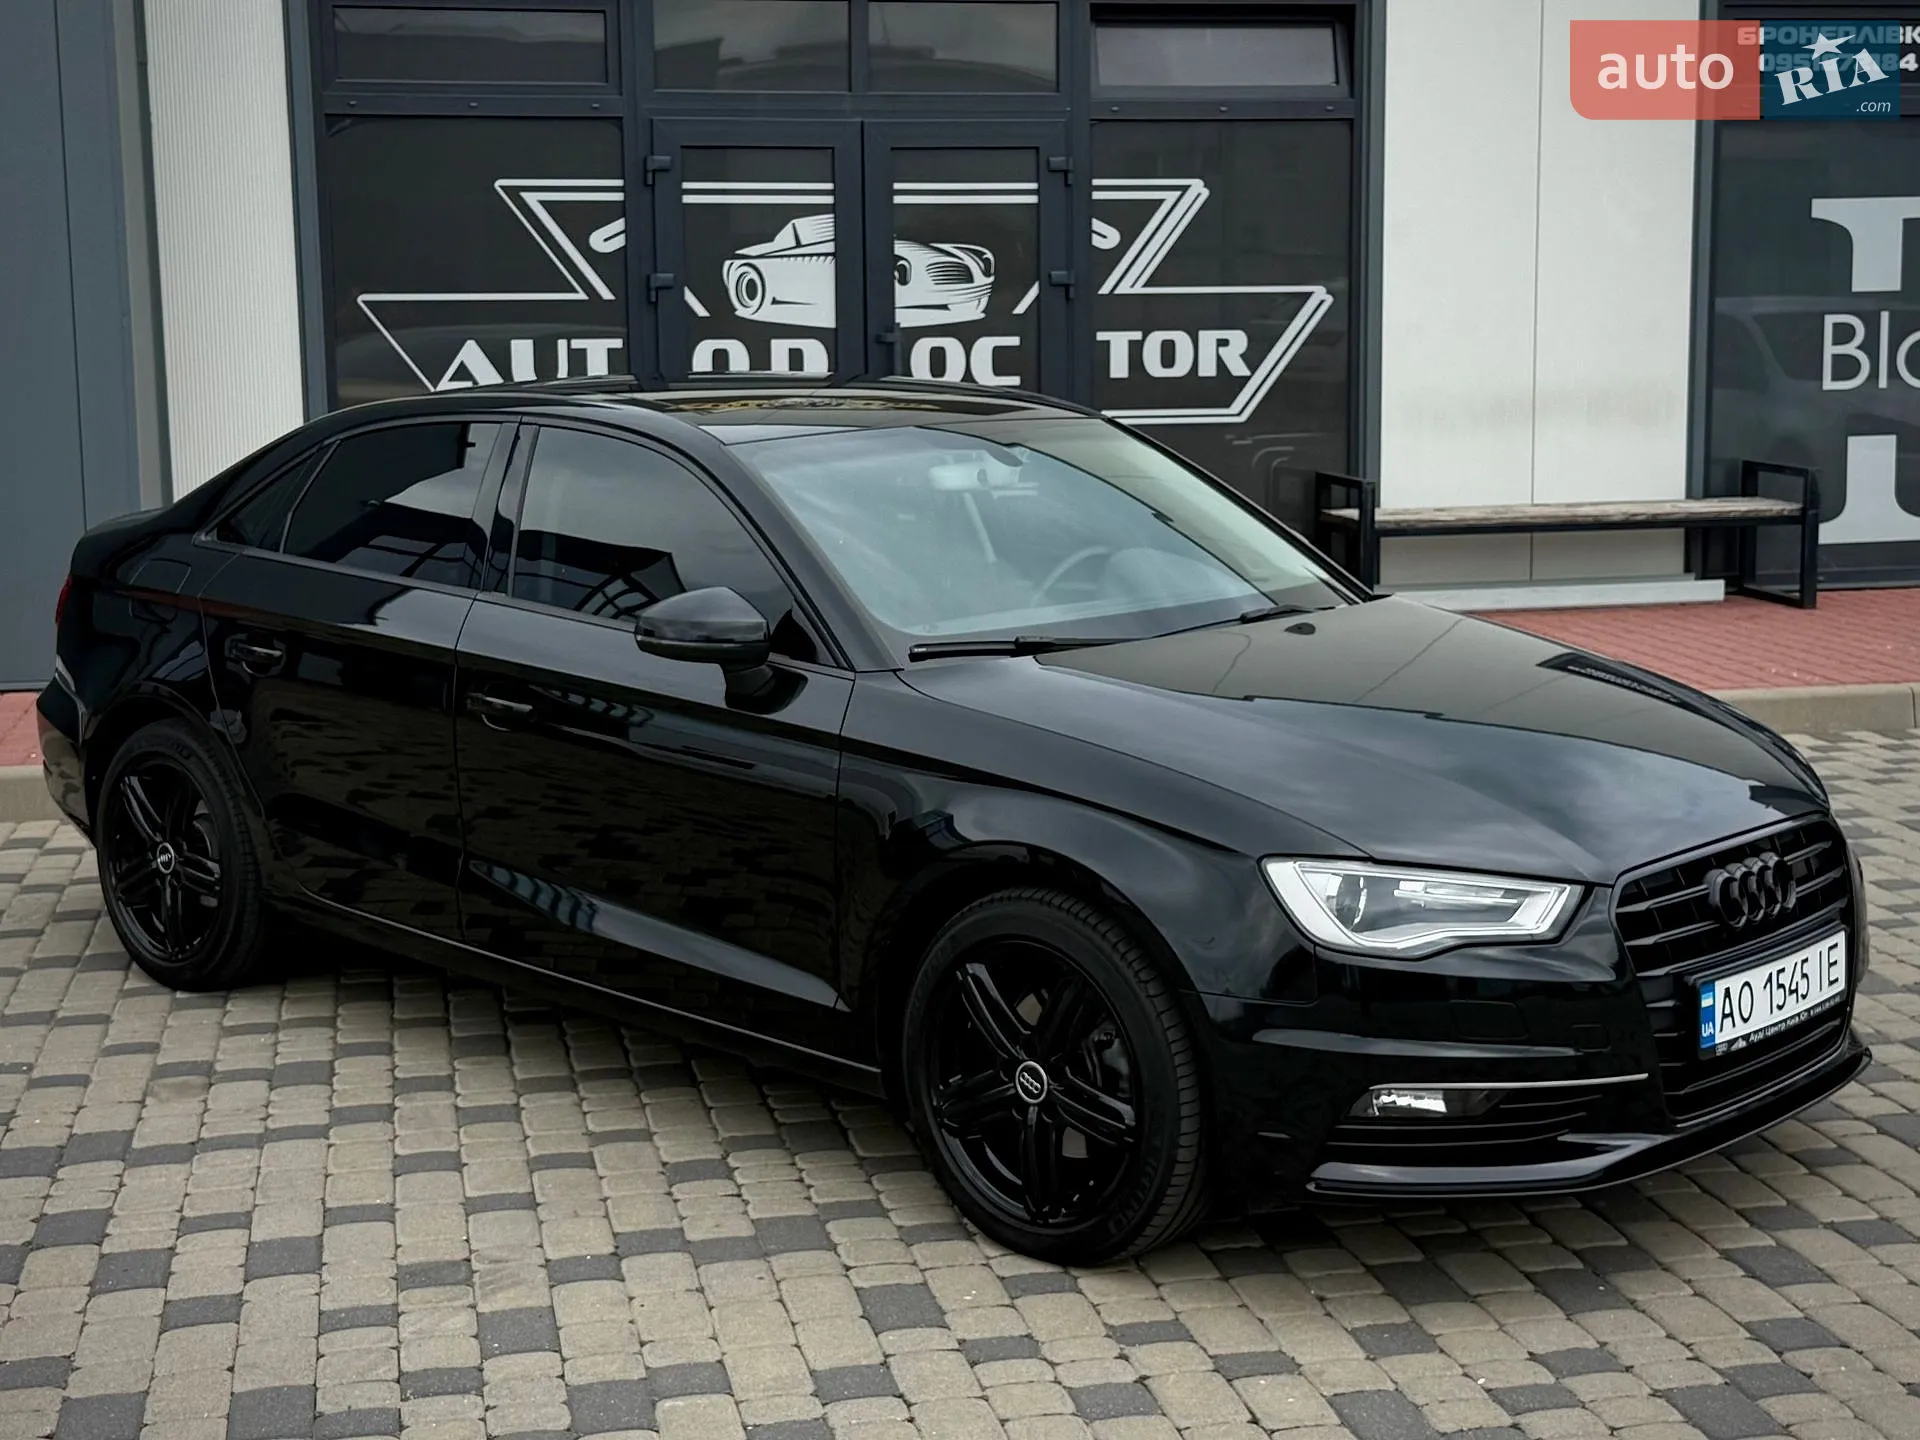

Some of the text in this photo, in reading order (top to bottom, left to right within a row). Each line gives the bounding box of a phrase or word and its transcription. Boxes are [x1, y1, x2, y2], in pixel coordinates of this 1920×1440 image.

[1719, 980, 1754, 1033] AO
[1763, 956, 1810, 1014] 1545
[1818, 942, 1840, 992] IE
[1701, 1021, 1715, 1037] UA
